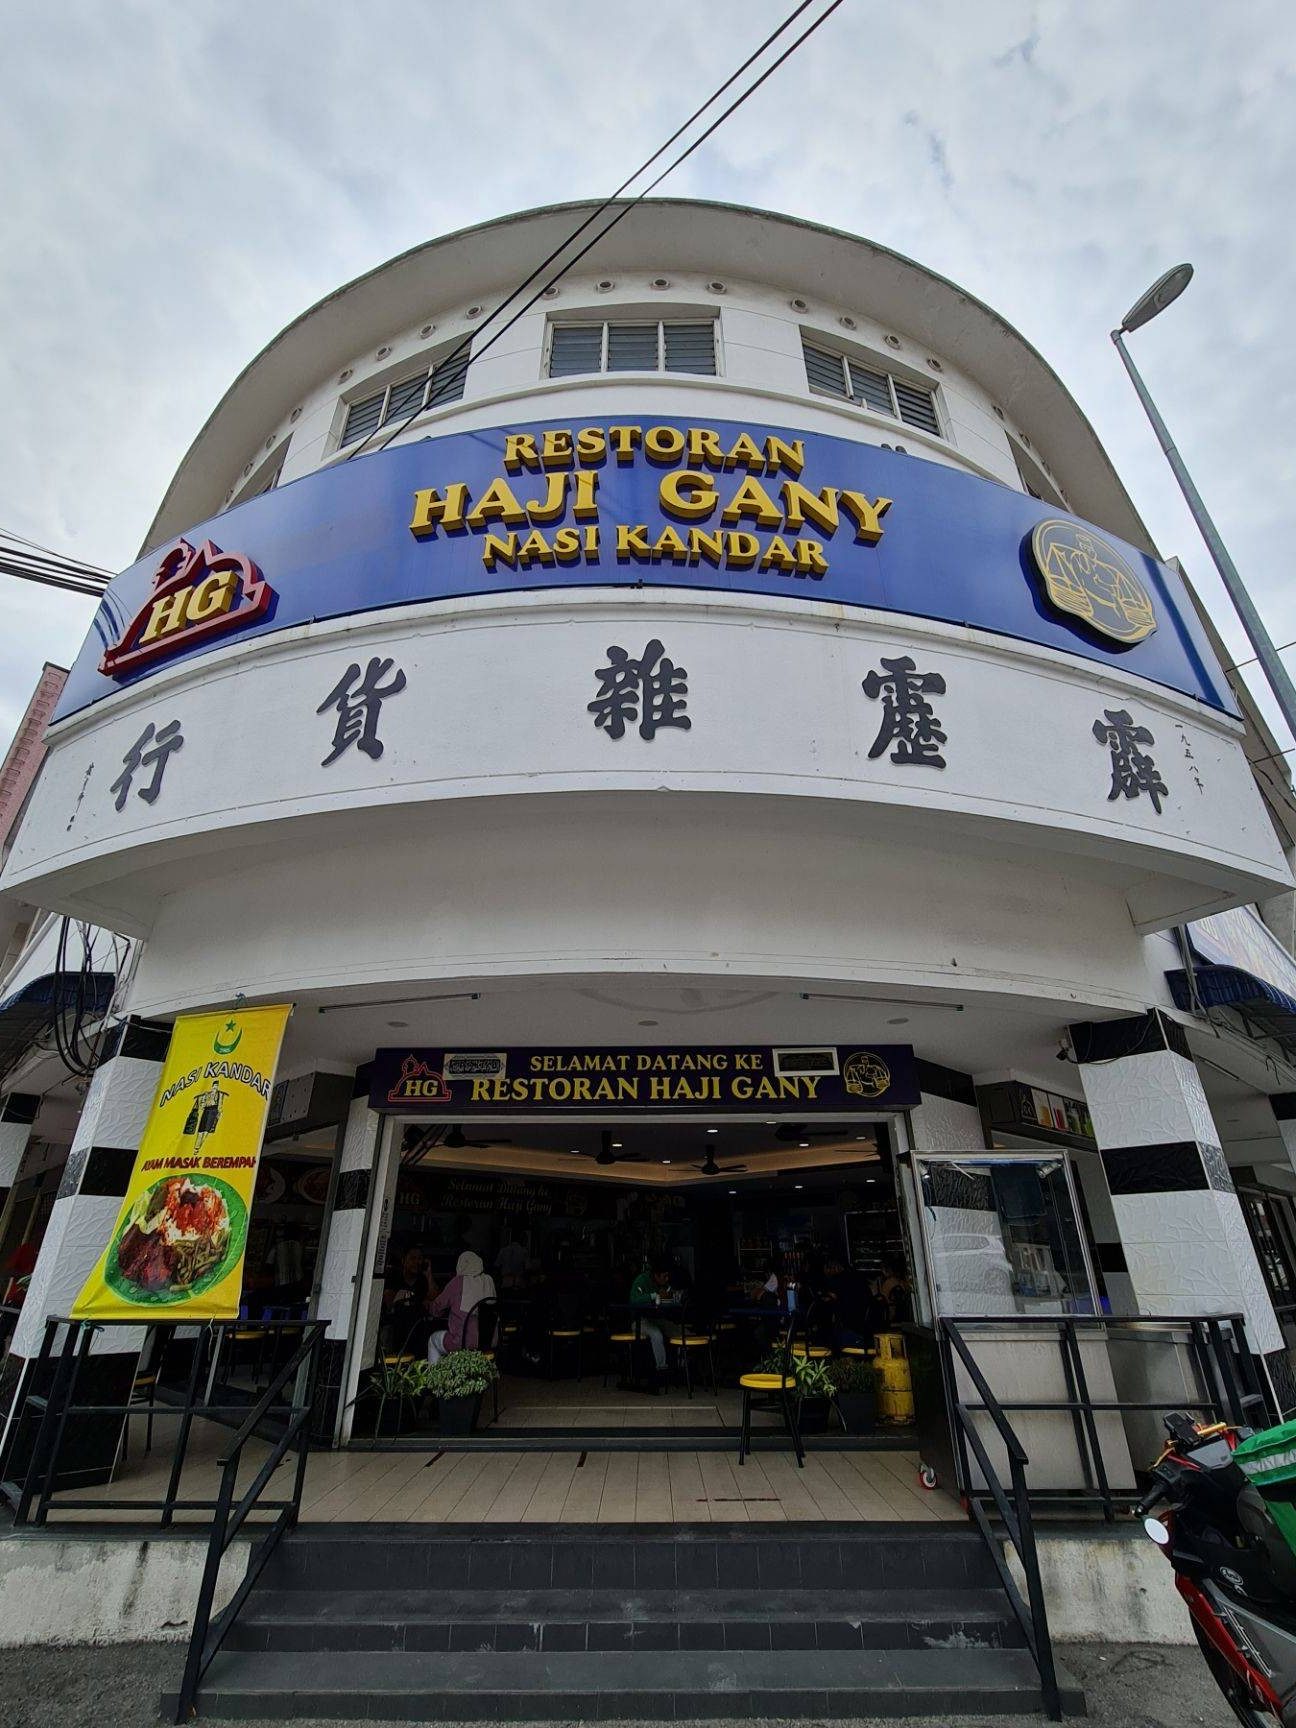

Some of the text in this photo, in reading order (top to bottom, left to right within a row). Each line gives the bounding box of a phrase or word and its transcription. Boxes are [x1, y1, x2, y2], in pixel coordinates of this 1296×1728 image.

[504, 426, 805, 474] RESTORAN
[408, 469, 894, 542] HAJI GANY
[482, 524, 829, 574] NASI KANDAR
[139, 570, 239, 644] HG
[159, 1060, 272, 1107] NASI KANDAR
[530, 1054, 630, 1072] SELAMAT
[637, 1054, 729, 1071] DATANG
[735, 1054, 764, 1070] KE
[403, 1079, 439, 1096] HG
[470, 1075, 822, 1101] RESTORAN HAJI GANY
[163, 1156, 202, 1169] MASAK
